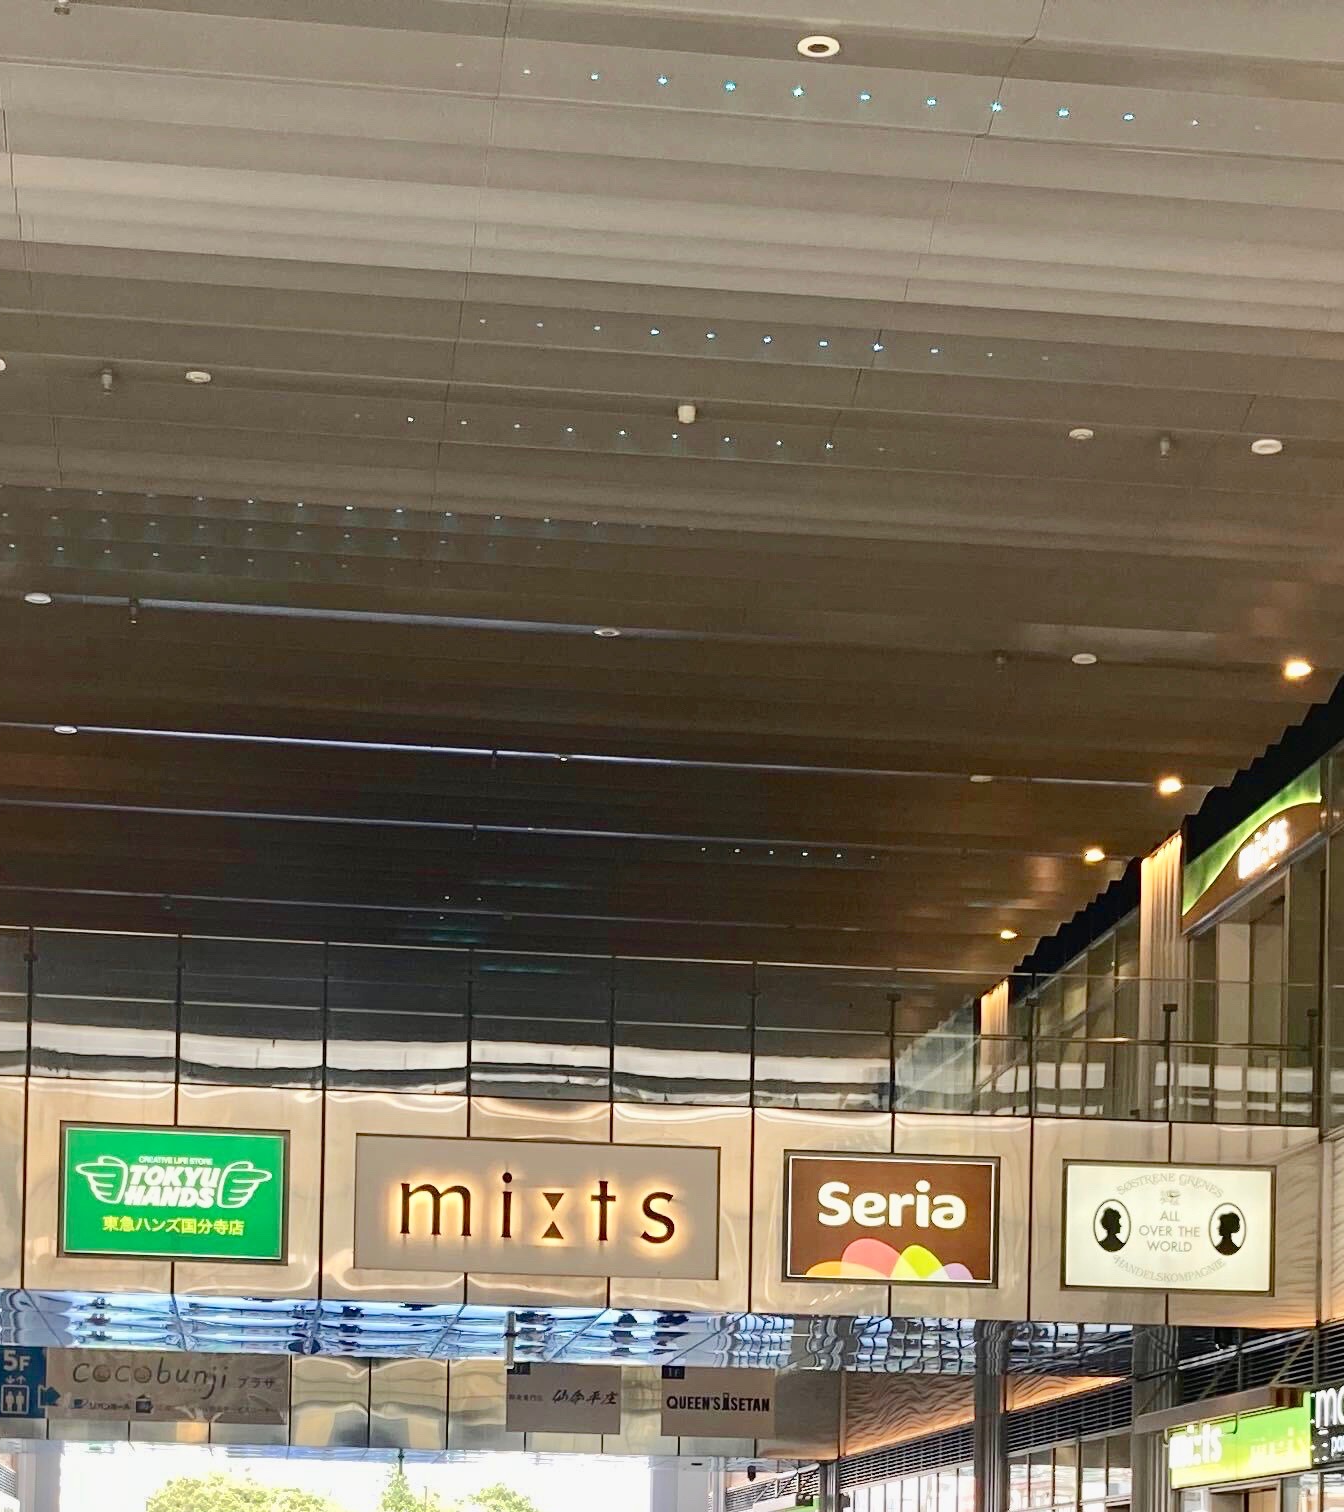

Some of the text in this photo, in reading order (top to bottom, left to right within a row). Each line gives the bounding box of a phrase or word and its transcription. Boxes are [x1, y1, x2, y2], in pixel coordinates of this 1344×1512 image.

[138, 1155, 174, 1165] CREATIVE
[129, 1165, 222, 1188] TOKYU
[1115, 1172, 1225, 1198] SØSTRENE GRENES
[123, 1185, 216, 1209] HANDS
[818, 1179, 967, 1229] Seria
[102, 1215, 245, 1236] 東急ハンズ国分寺店
[1159, 1210, 1181, 1222] ALL
[1138, 1225, 1201, 1238] OVER THE
[1146, 1240, 1193, 1253] WORLD
[3, 1350, 31, 1371] 5F
[72, 1356, 229, 1399] cocobunji
